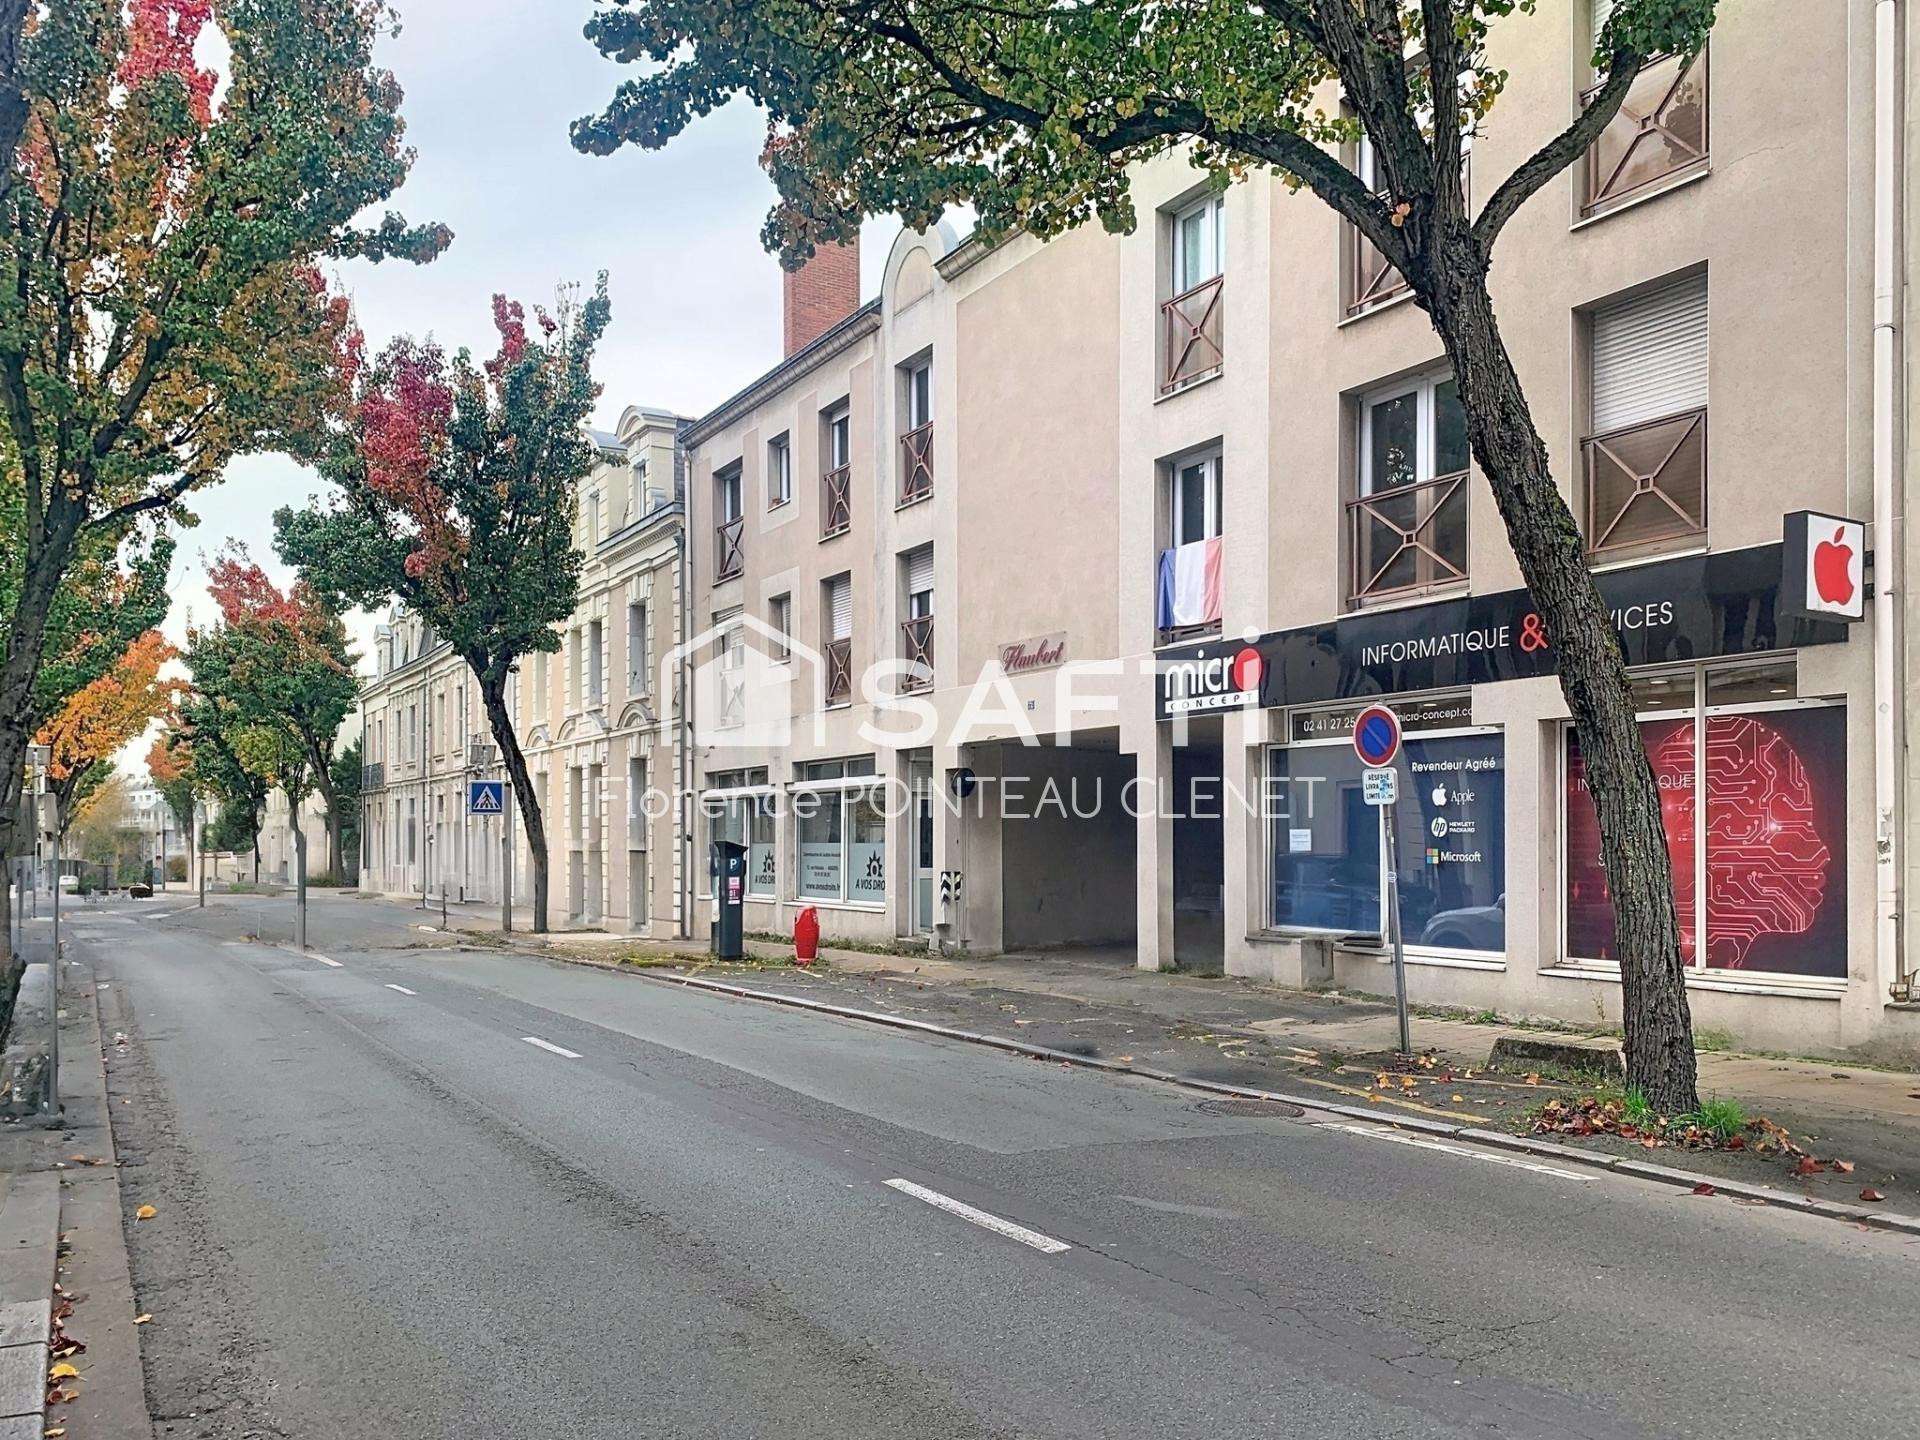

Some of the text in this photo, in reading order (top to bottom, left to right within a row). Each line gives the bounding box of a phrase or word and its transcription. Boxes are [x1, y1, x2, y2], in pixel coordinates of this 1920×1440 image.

[1363, 626, 1510, 666] INFORMATIQUE
[1520, 613, 1549, 652] &
[1170, 693, 1252, 711] CONCEPT
[1303, 720, 1314, 732] 02
[1317, 719, 1326, 731] 41
[1331, 717, 1341, 729] 27
[1412, 757, 1496, 772] Revendeur Agréé
[1451, 789, 1475, 805] Apple
[730, 858, 737, 869] P
[1440, 851, 1481, 862] Microsoft
[855, 880, 860, 889] A
[861, 880, 872, 890] VOS
